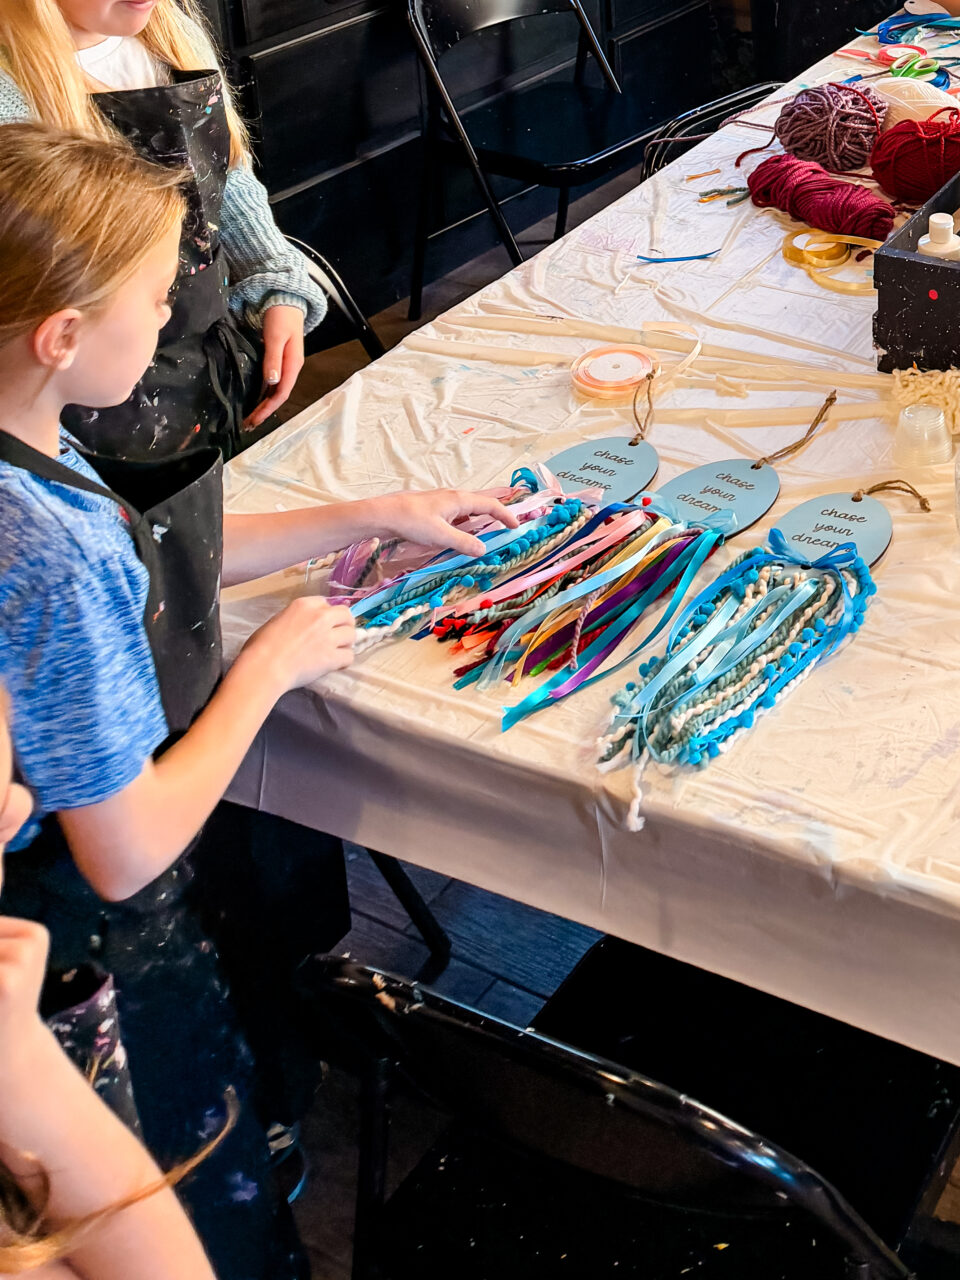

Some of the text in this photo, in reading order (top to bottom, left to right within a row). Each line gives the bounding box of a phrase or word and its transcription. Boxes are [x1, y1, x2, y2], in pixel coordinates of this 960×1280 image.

[593, 449, 634, 466] chase
[579, 462, 616, 477] your
[715, 473, 755, 490] chase
[699, 485, 736, 502] your
[820, 508, 868, 523] chase
[812, 522, 854, 537] your
